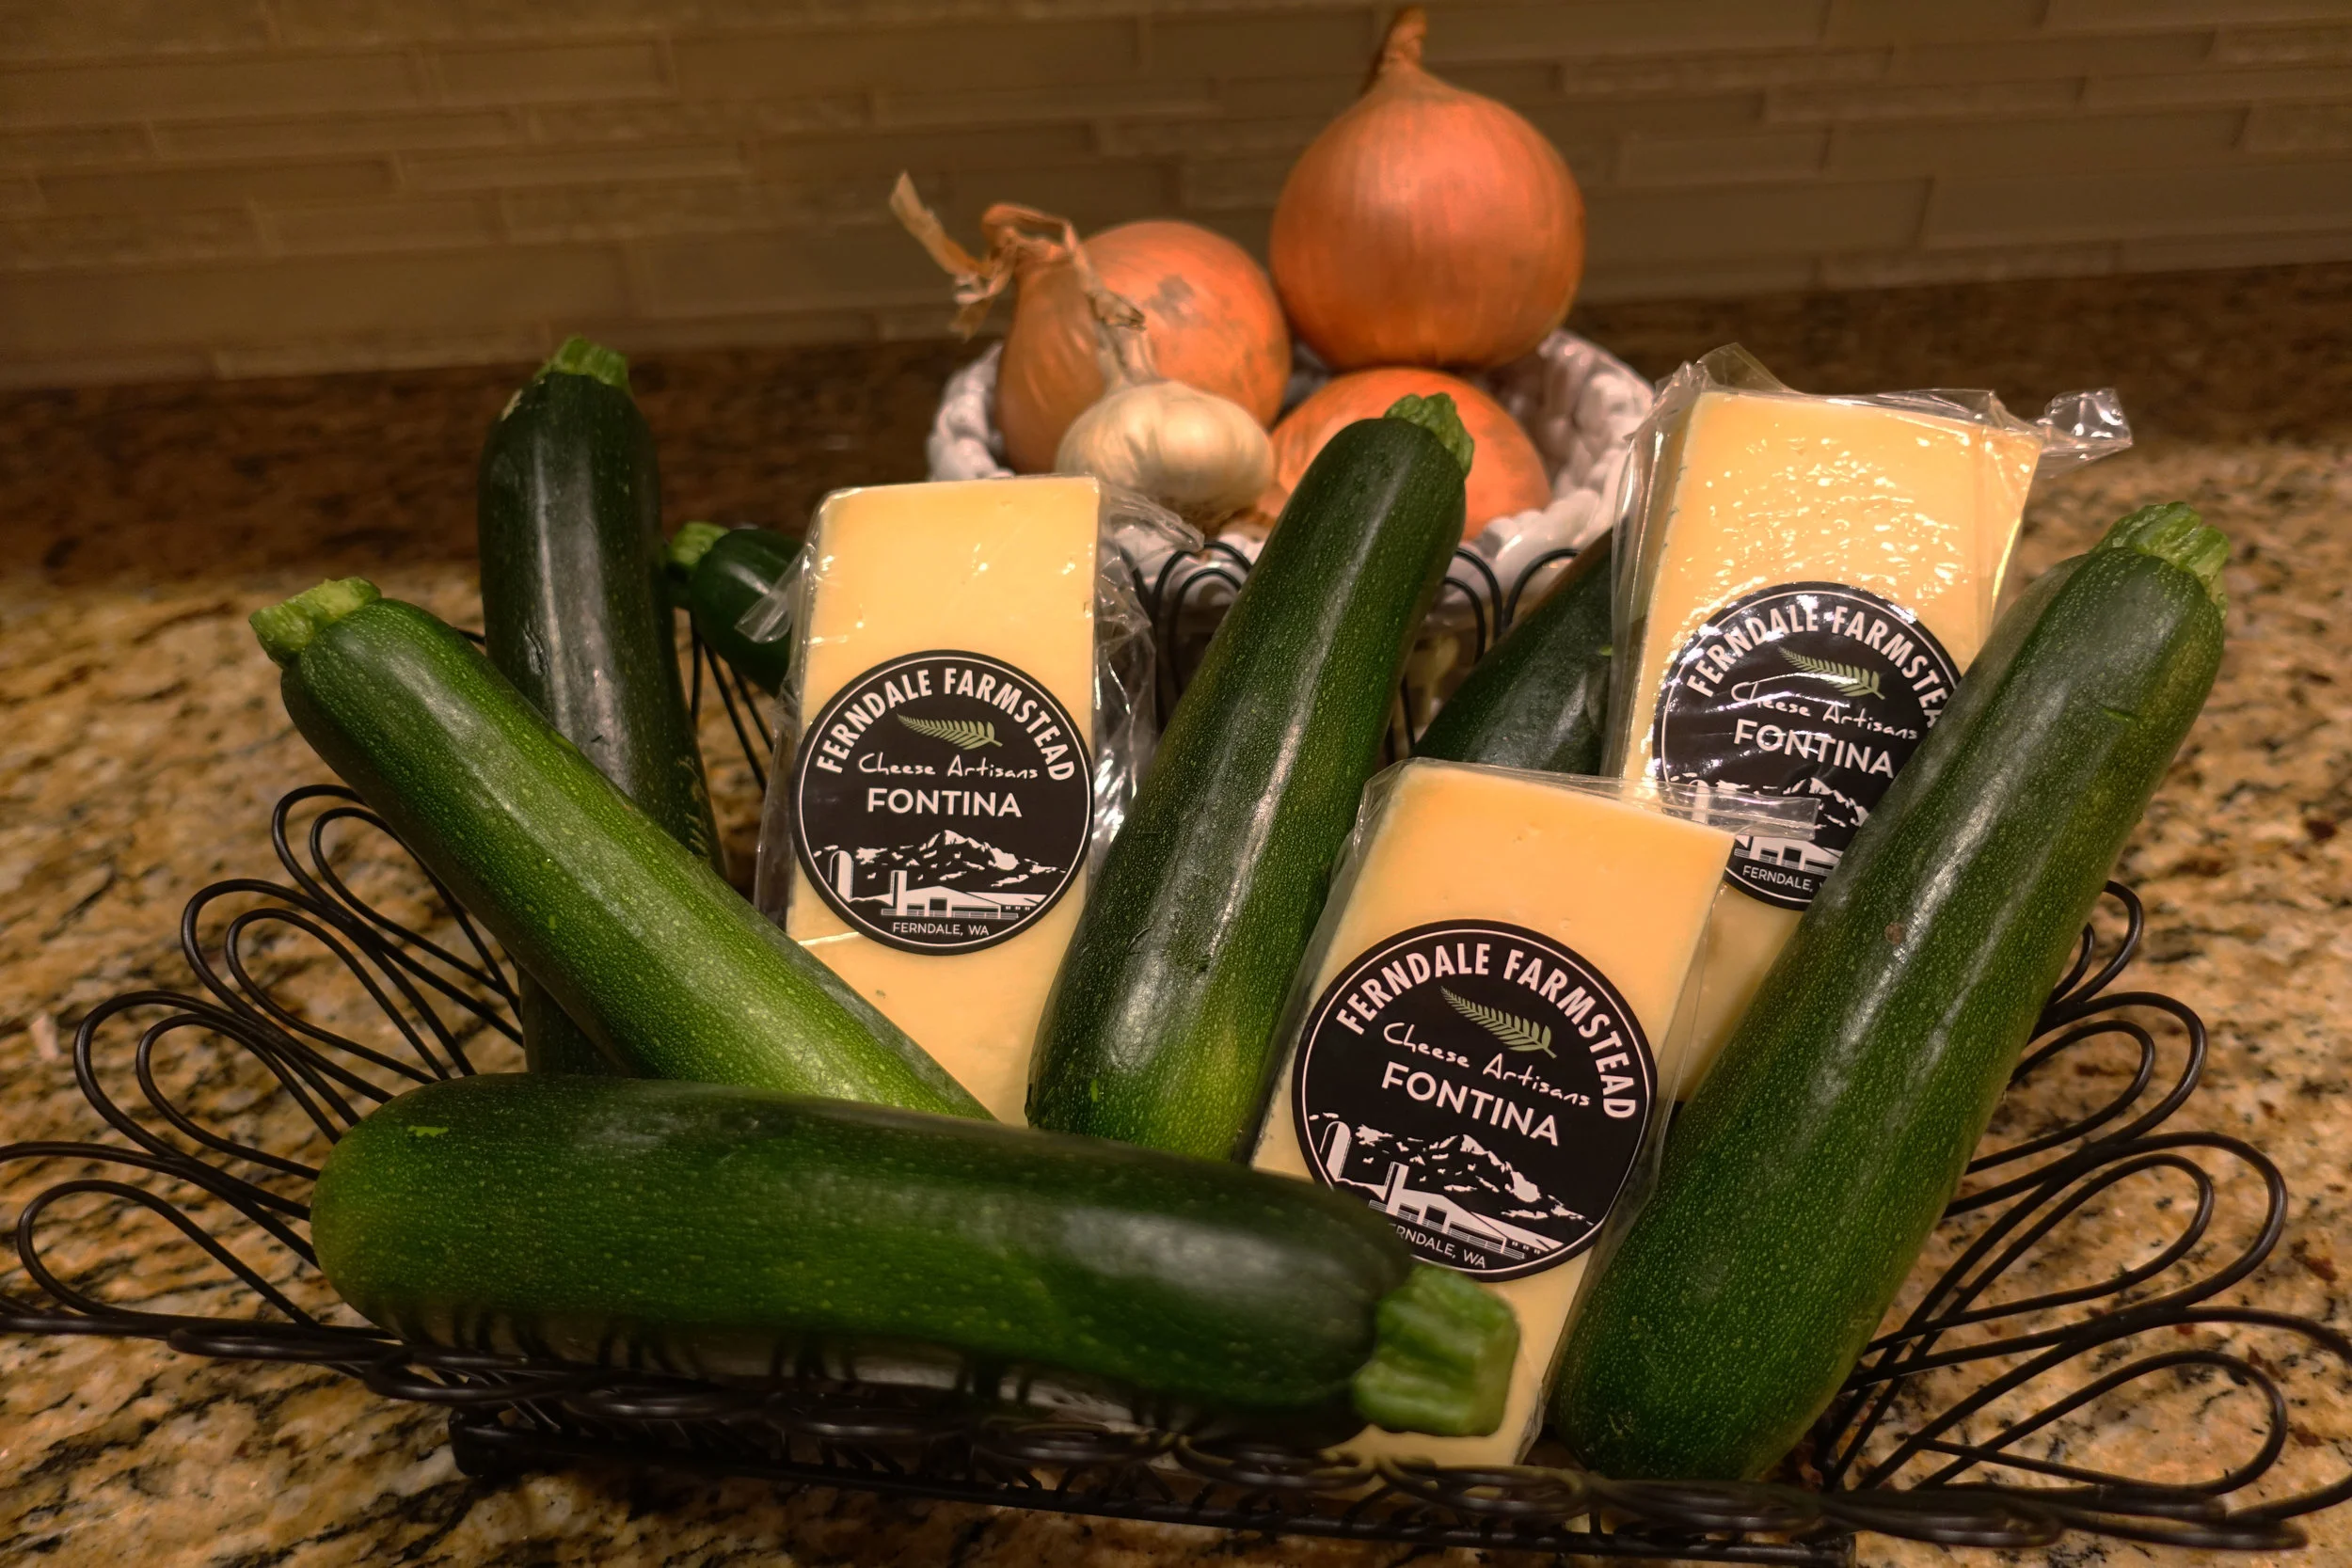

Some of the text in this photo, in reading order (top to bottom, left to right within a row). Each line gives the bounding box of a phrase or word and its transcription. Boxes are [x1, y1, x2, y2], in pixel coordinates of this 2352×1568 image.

[1686, 603, 1948, 728] FERNDALE FARMSTEA
[816, 668, 1075, 781] FERNDALE FARMSTEAD
[1730, 681, 1918, 740] Cheese Artisans
[858, 752, 1039, 779] Cheese Artisans
[1733, 719, 1895, 780] FONTINA
[866, 787, 1023, 818] FONTINA
[1741, 864, 1814, 893] FERNDALE,
[892, 922, 990, 937] FERNDALE, WA
[1335, 942, 1637, 1119] FERNDALE FARMSTEAD
[1382, 1022, 1591, 1108] Cheese Artisans
[1380, 1060, 1560, 1148] FONTINA
[1389, 1223, 1486, 1270] RNDALE, WA
